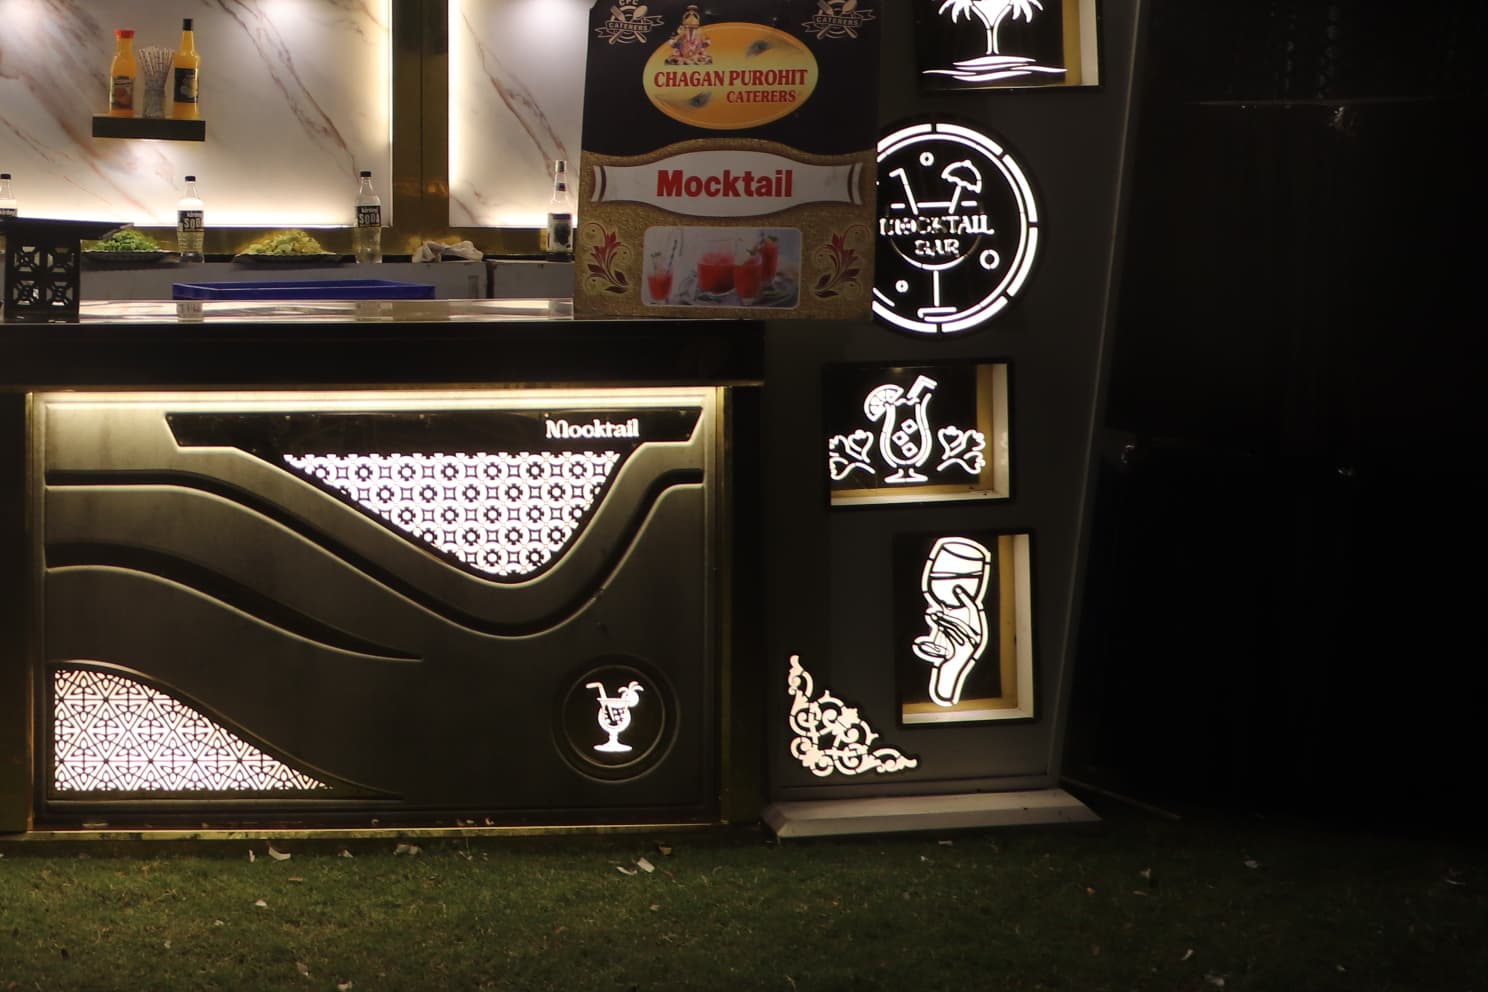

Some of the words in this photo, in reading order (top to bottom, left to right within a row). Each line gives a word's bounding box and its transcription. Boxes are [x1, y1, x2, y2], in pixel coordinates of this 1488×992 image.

[815, 16, 859, 26] CATERERS
[654, 70, 725, 88] CHAGAN
[727, 69, 808, 86] PUROHIT
[726, 90, 797, 104] CATERERS
[656, 169, 793, 198] Mocktail
[545, 418, 639, 438] Mocktail
